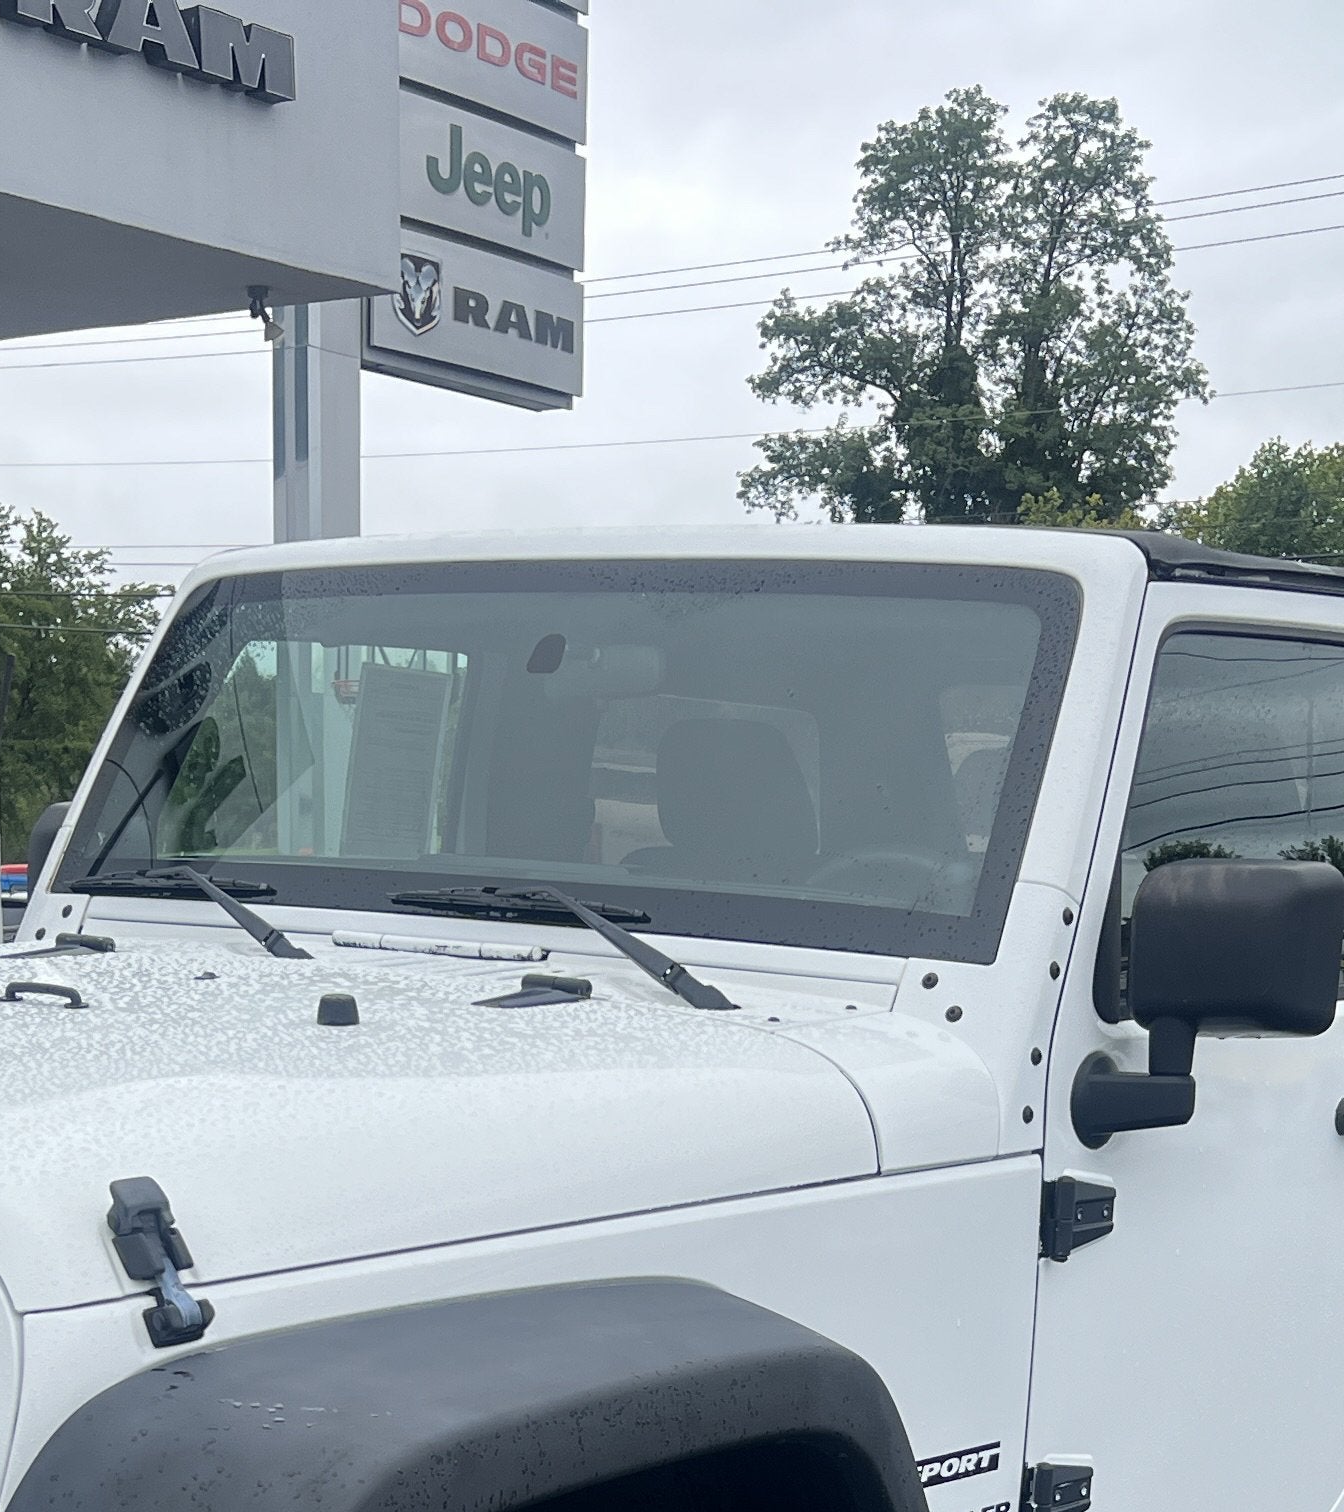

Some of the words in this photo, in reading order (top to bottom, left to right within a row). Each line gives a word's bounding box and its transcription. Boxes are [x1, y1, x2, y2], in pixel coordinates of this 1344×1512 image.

[399, 0, 578, 99] DODGE
[426, 123, 551, 237] Jeep
[452, 285, 575, 354] RAM
